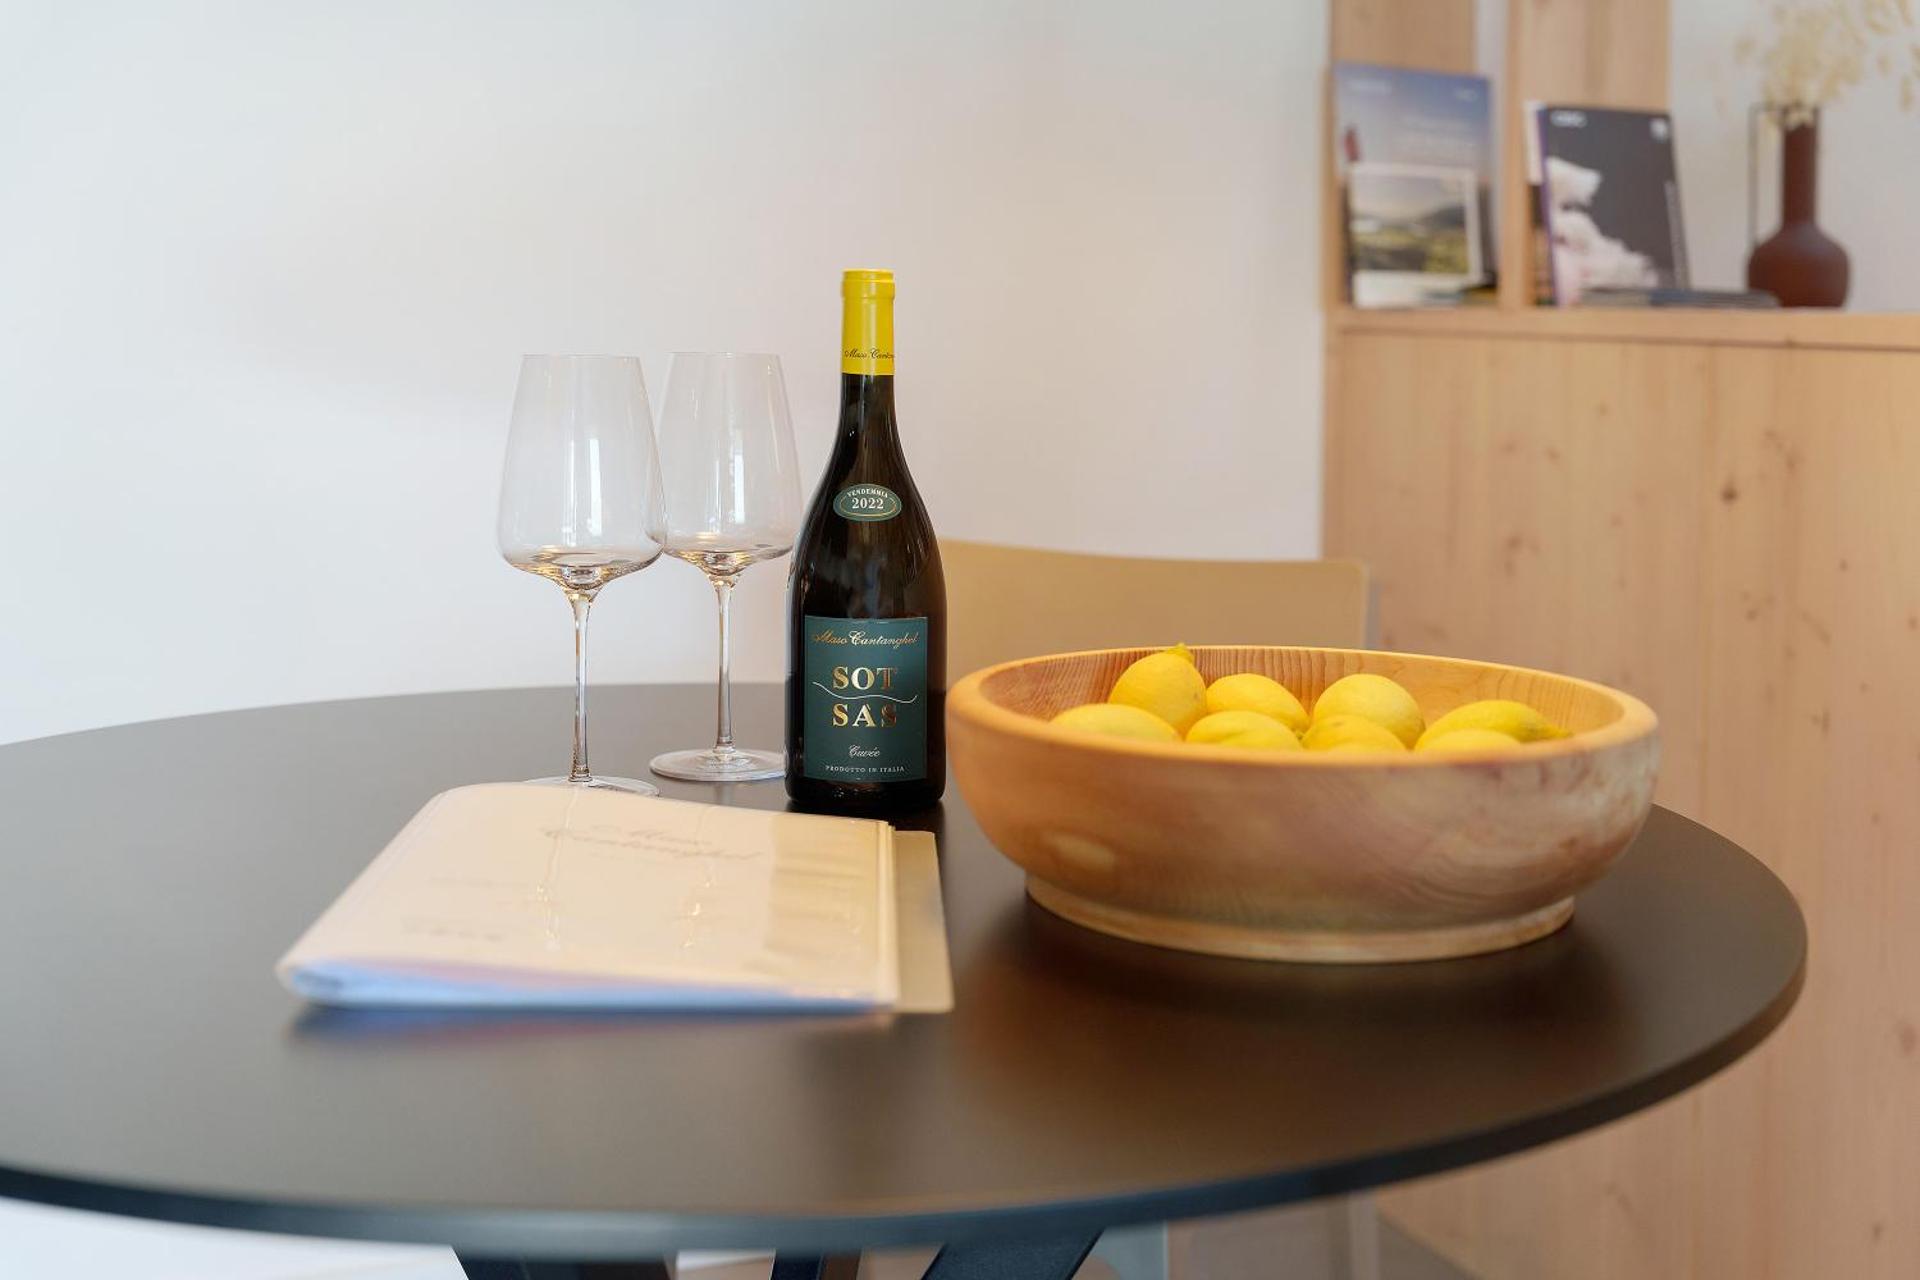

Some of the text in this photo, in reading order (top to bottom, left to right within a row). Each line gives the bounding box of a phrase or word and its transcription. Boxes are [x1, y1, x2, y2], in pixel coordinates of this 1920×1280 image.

[846, 488, 889, 499] VENDEMMIA
[851, 498, 885, 509] 2022
[814, 630, 918, 649] Maso Cantanghel
[832, 666, 897, 690] SOT
[832, 703, 897, 728] SAS
[848, 744, 880, 758] Cuvée
[825, 765, 866, 773] PRODOTTO
